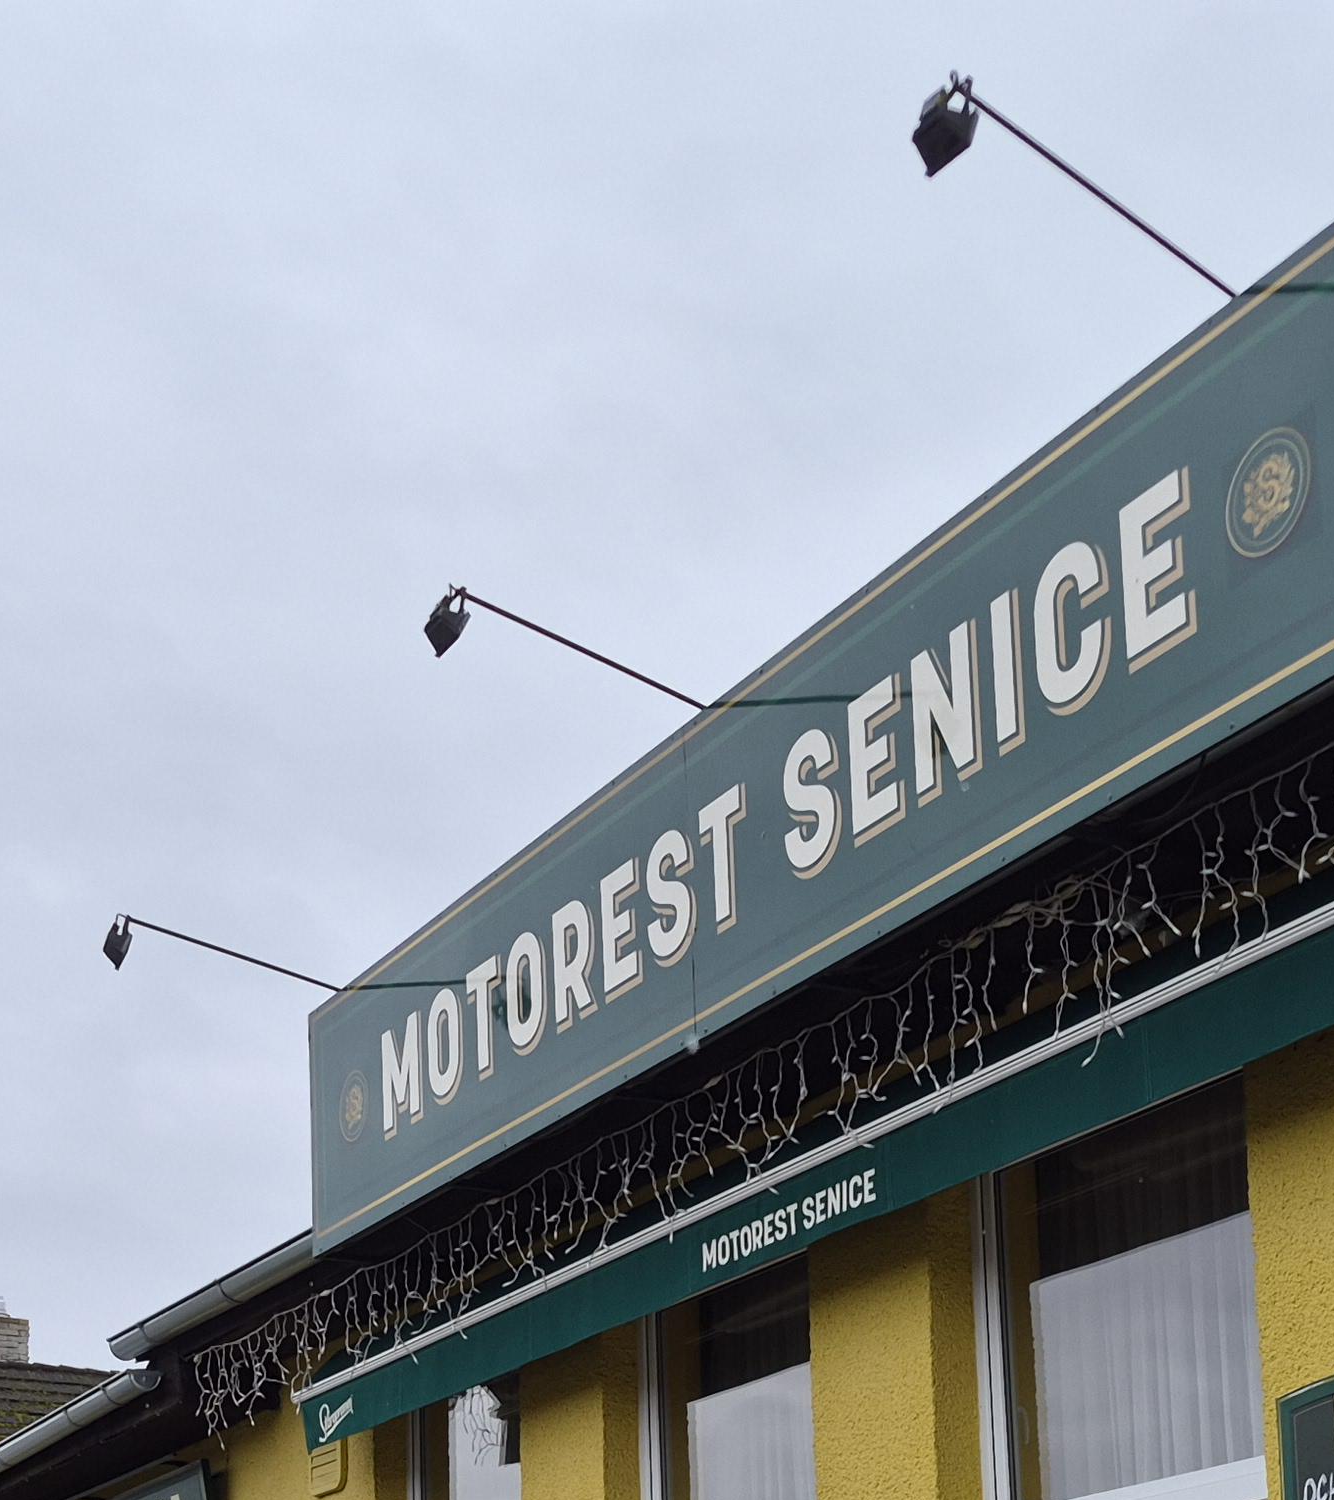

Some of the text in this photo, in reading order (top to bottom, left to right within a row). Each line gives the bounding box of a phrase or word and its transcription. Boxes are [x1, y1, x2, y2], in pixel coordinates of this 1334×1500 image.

[381, 466, 1198, 1141] MOTOREST SENICE
[701, 1168, 877, 1273] MOTOREST SENICE
